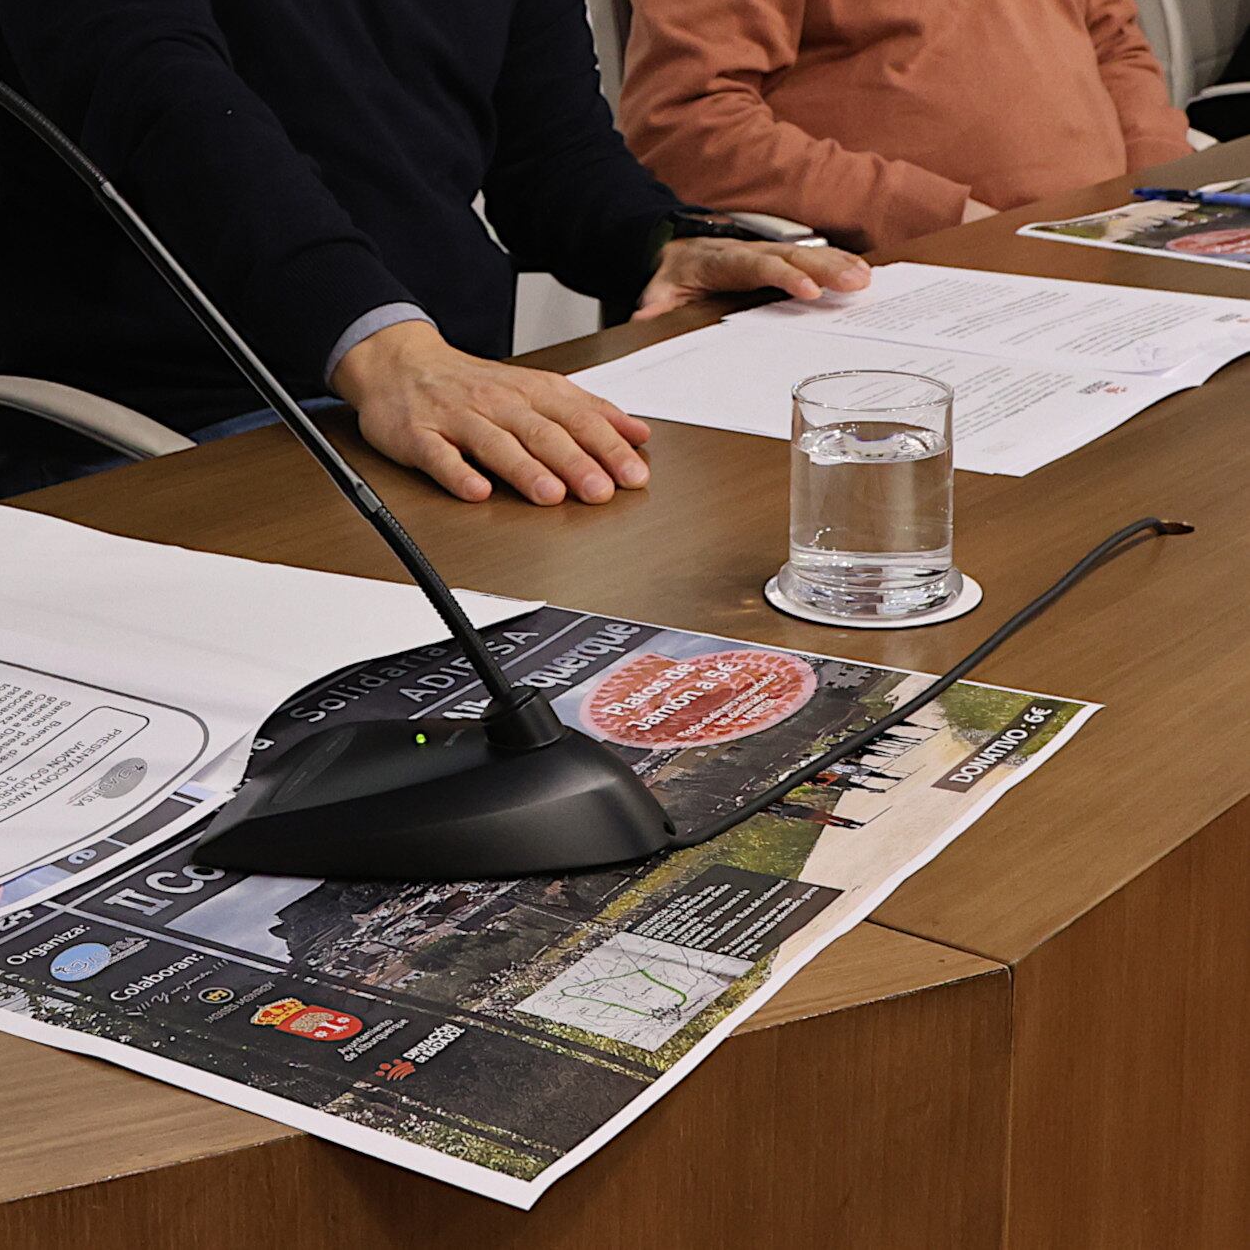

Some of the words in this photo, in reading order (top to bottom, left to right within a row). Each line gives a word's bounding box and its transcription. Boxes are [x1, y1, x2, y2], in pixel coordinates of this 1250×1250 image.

[398, 626, 540, 703] ADIFSA
[704, 661, 743, 681] 5€
[291, 643, 448, 724] Solidaria
[600, 676, 671, 716] Platos
[665, 661, 696, 682] de
[696, 679, 717, 694] a
[21, 696, 56, 721] gracias
[20, 720, 61, 746] Buenos
[677, 721, 705, 737] Todo
[949, 729, 1029, 784] DONATIVO
[1023, 705, 1053, 724] 6€
[39, 729, 120, 785] PRESENTACIÓN
[46, 741, 87, 767] JAMÓN
[104, 888, 174, 917] II
[7, 924, 91, 966] Organiza:
[109, 953, 205, 1002] Colaboran:
[336, 1018, 394, 1055] Ayuntamiento
[343, 1051, 356, 1062] de
[356, 1017, 410, 1057] Alburquerque
[402, 1023, 456, 1061] DIPUTACIÓN
[422, 1026, 466, 1059] BADAJOZ
